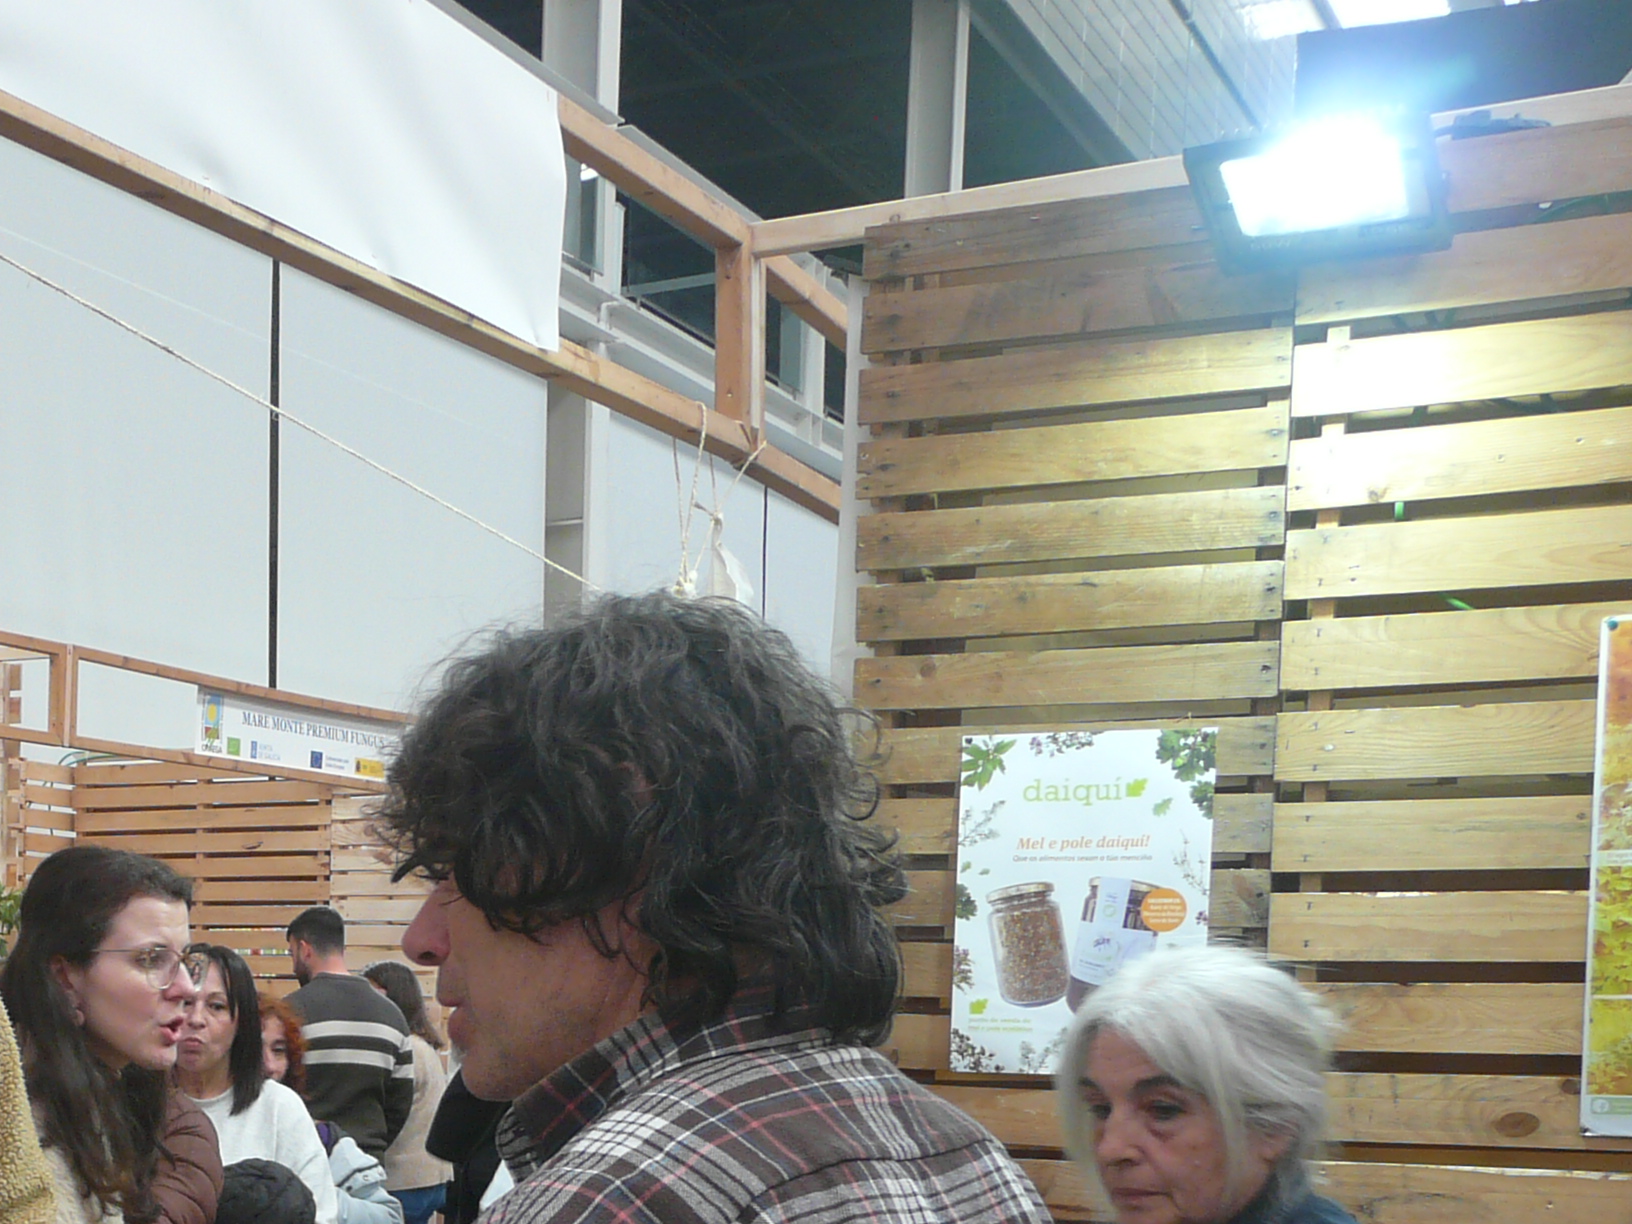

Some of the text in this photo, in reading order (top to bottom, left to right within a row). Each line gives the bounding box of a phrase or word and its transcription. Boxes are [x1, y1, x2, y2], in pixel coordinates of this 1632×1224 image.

[241, 711, 270, 729] MARE
[271, 716, 305, 735] MONTE
[306, 722, 349, 743] PREMIUM
[1023, 777, 1122, 806] daiquí
[1016, 837, 1045, 850] Mel
[1049, 840, 1057, 850] e
[1059, 836, 1093, 852] pole
